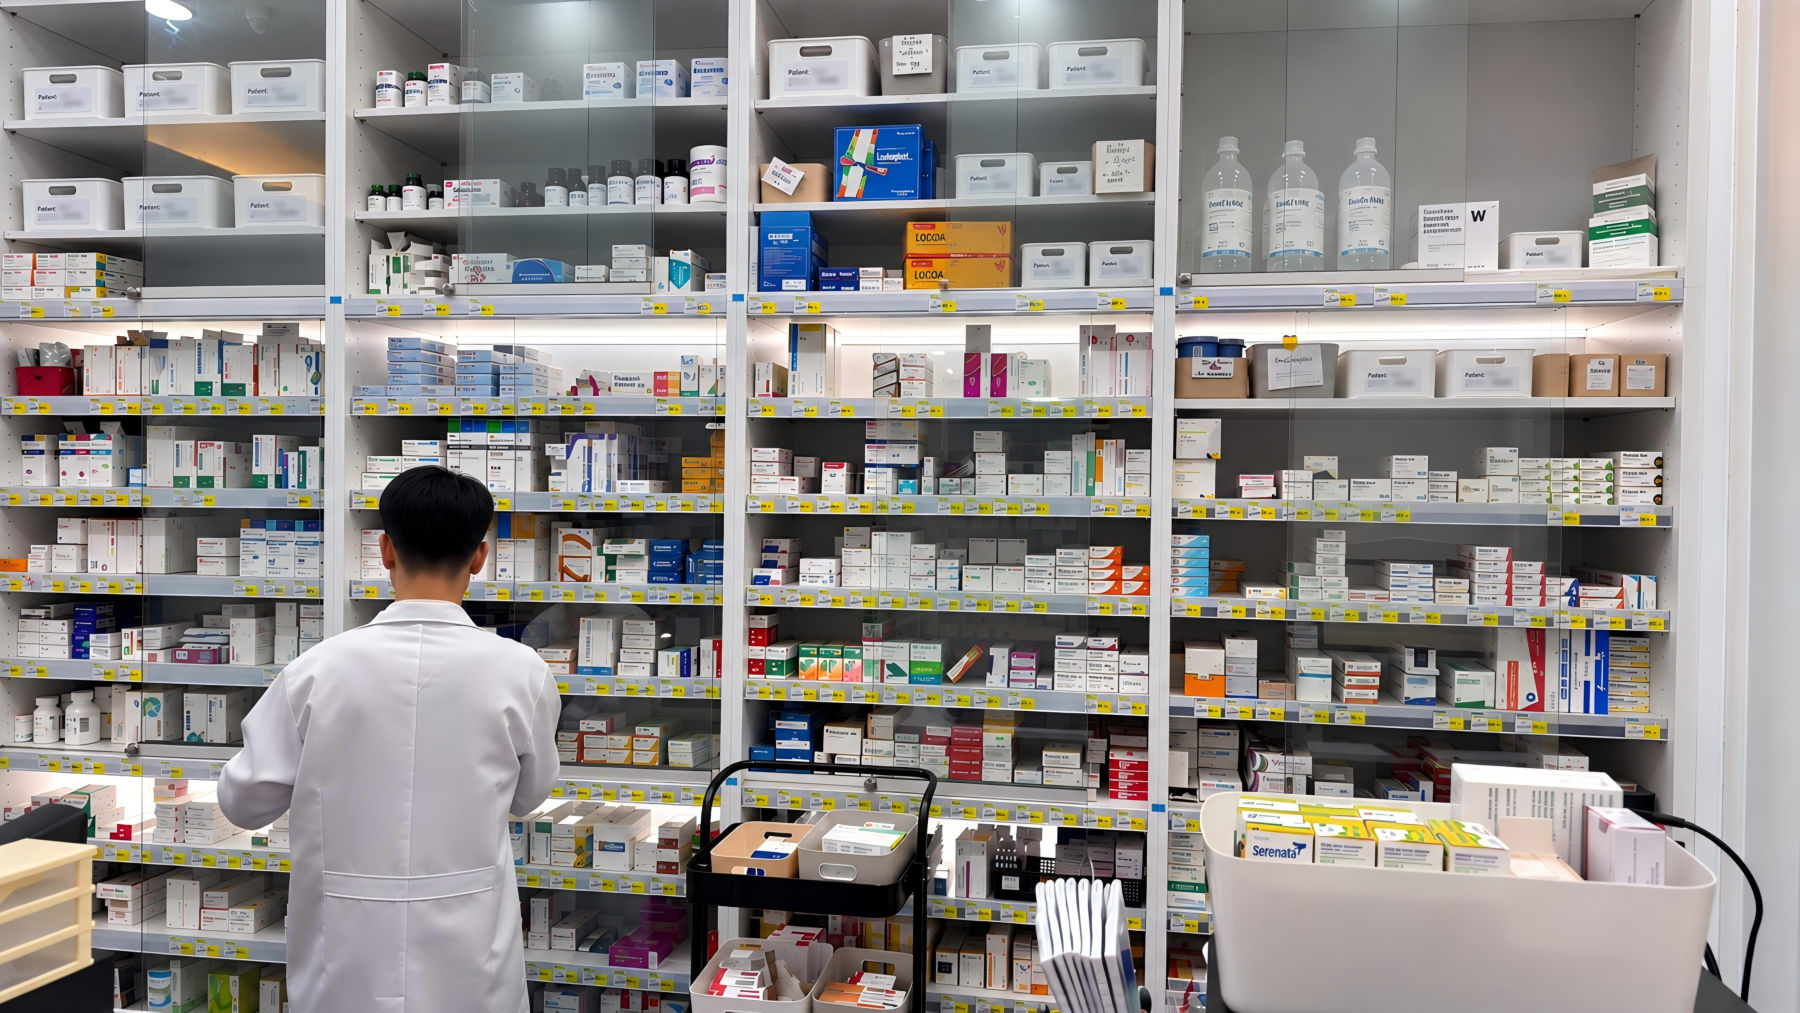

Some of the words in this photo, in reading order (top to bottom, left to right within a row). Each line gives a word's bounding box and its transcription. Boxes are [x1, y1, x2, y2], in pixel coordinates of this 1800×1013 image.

[1471, 210, 1486, 222] W
[914, 270, 944, 280] LOCOA
[1252, 844, 1297, 859] Serenata
